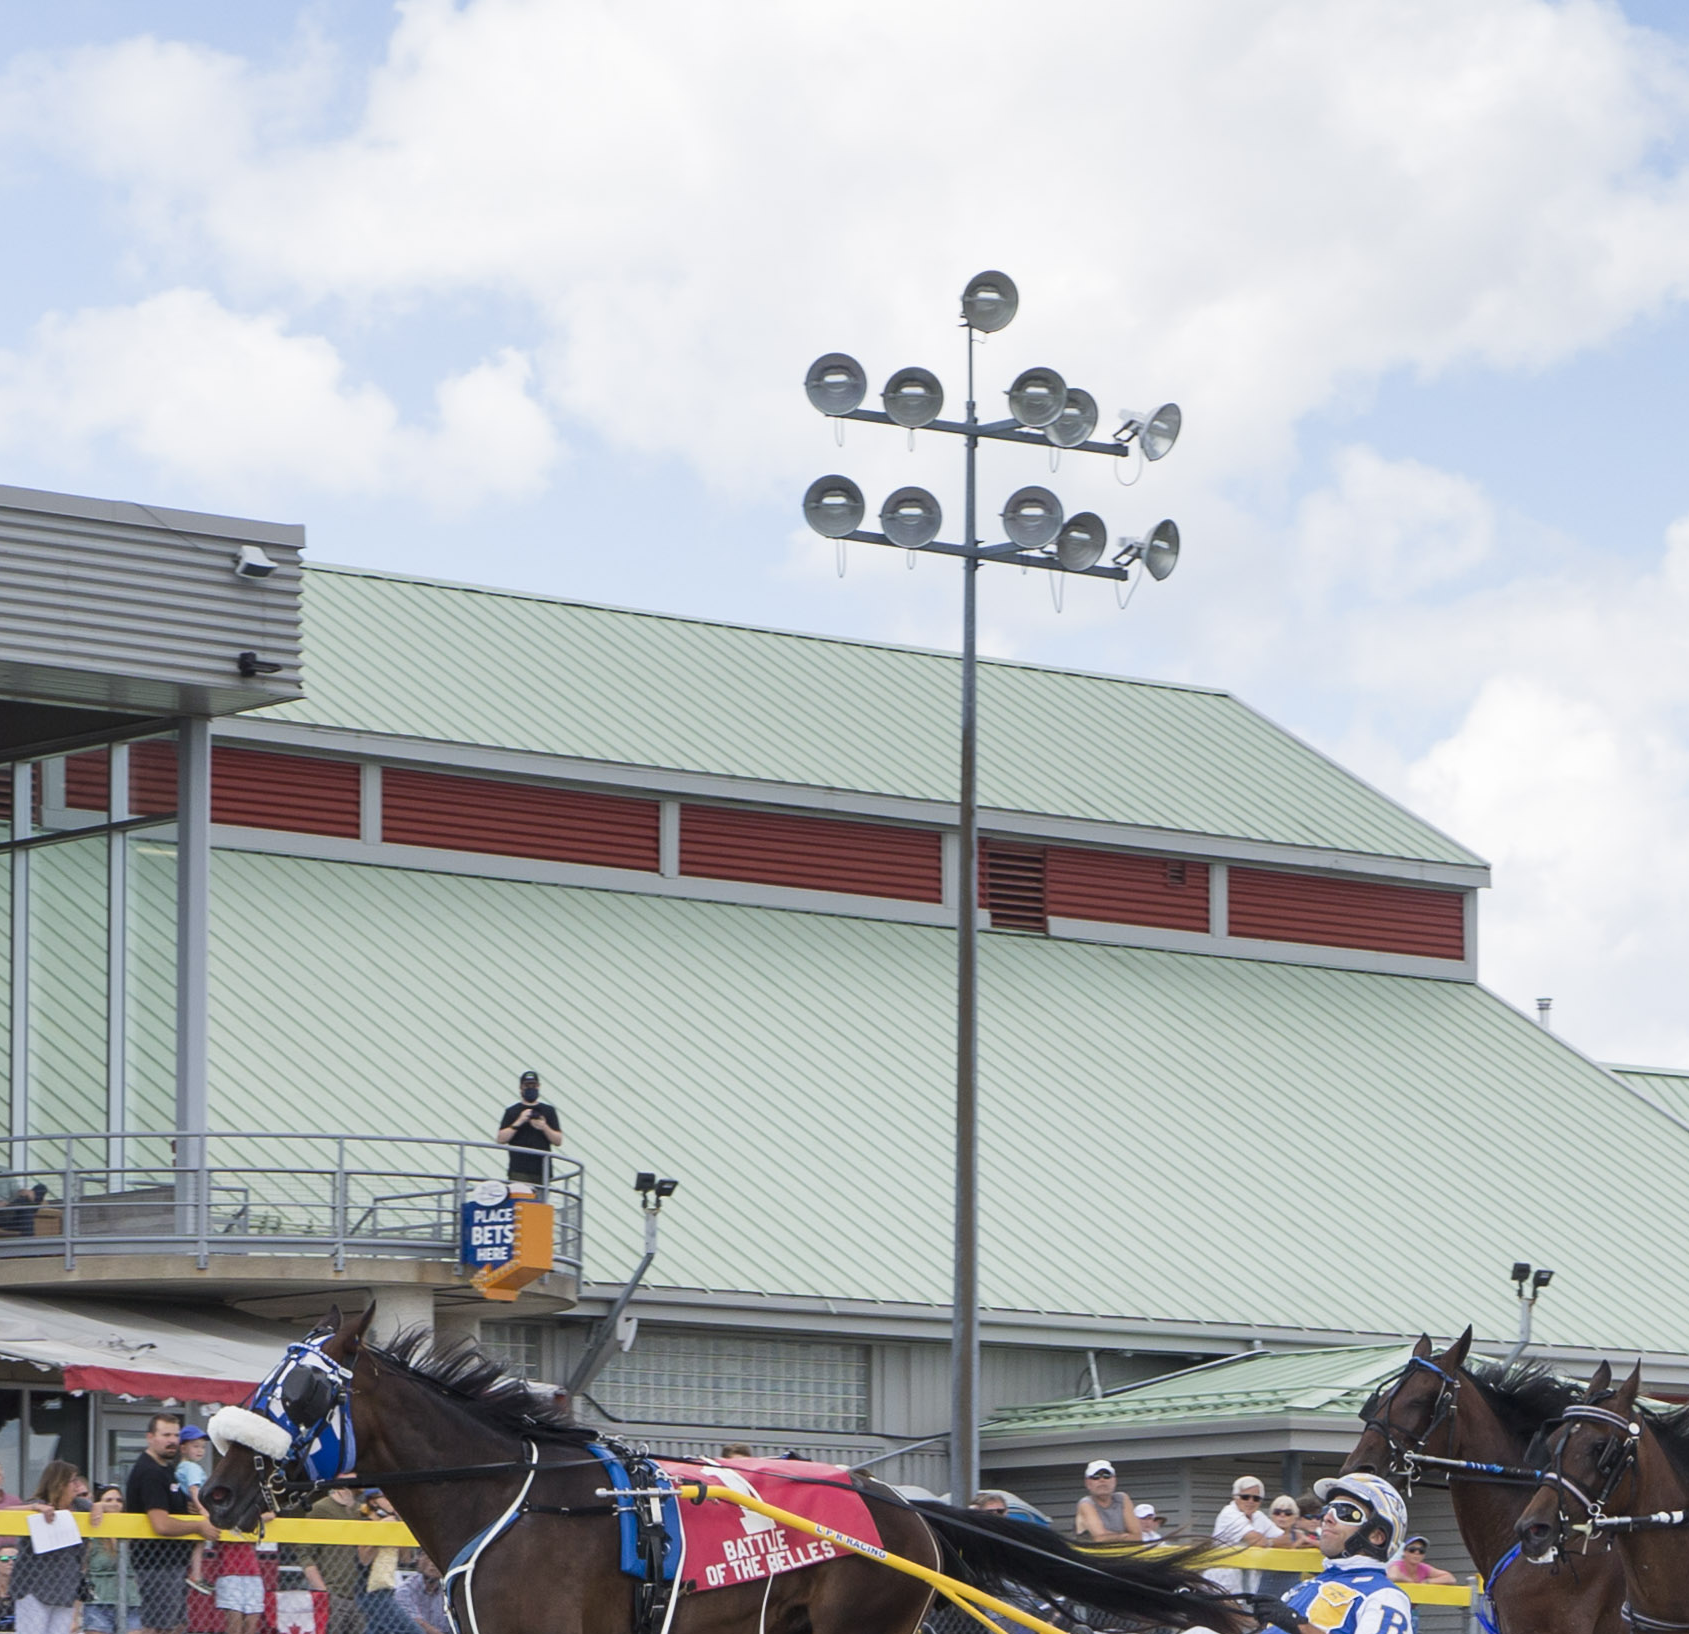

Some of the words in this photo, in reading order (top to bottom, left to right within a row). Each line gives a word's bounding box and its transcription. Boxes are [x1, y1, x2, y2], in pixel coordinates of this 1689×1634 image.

[473, 1209, 513, 1224] PLACE
[471, 1224, 515, 1246] BETS
[476, 1246, 509, 1261] HERE
[700, 1466, 777, 1534] 1
[722, 1530, 789, 1561] BATTLE
[846, 1537, 886, 1559] RACING
[705, 1565, 727, 1586] OF
[730, 1554, 765, 1580] THE
[765, 1540, 836, 1574] BELLES
